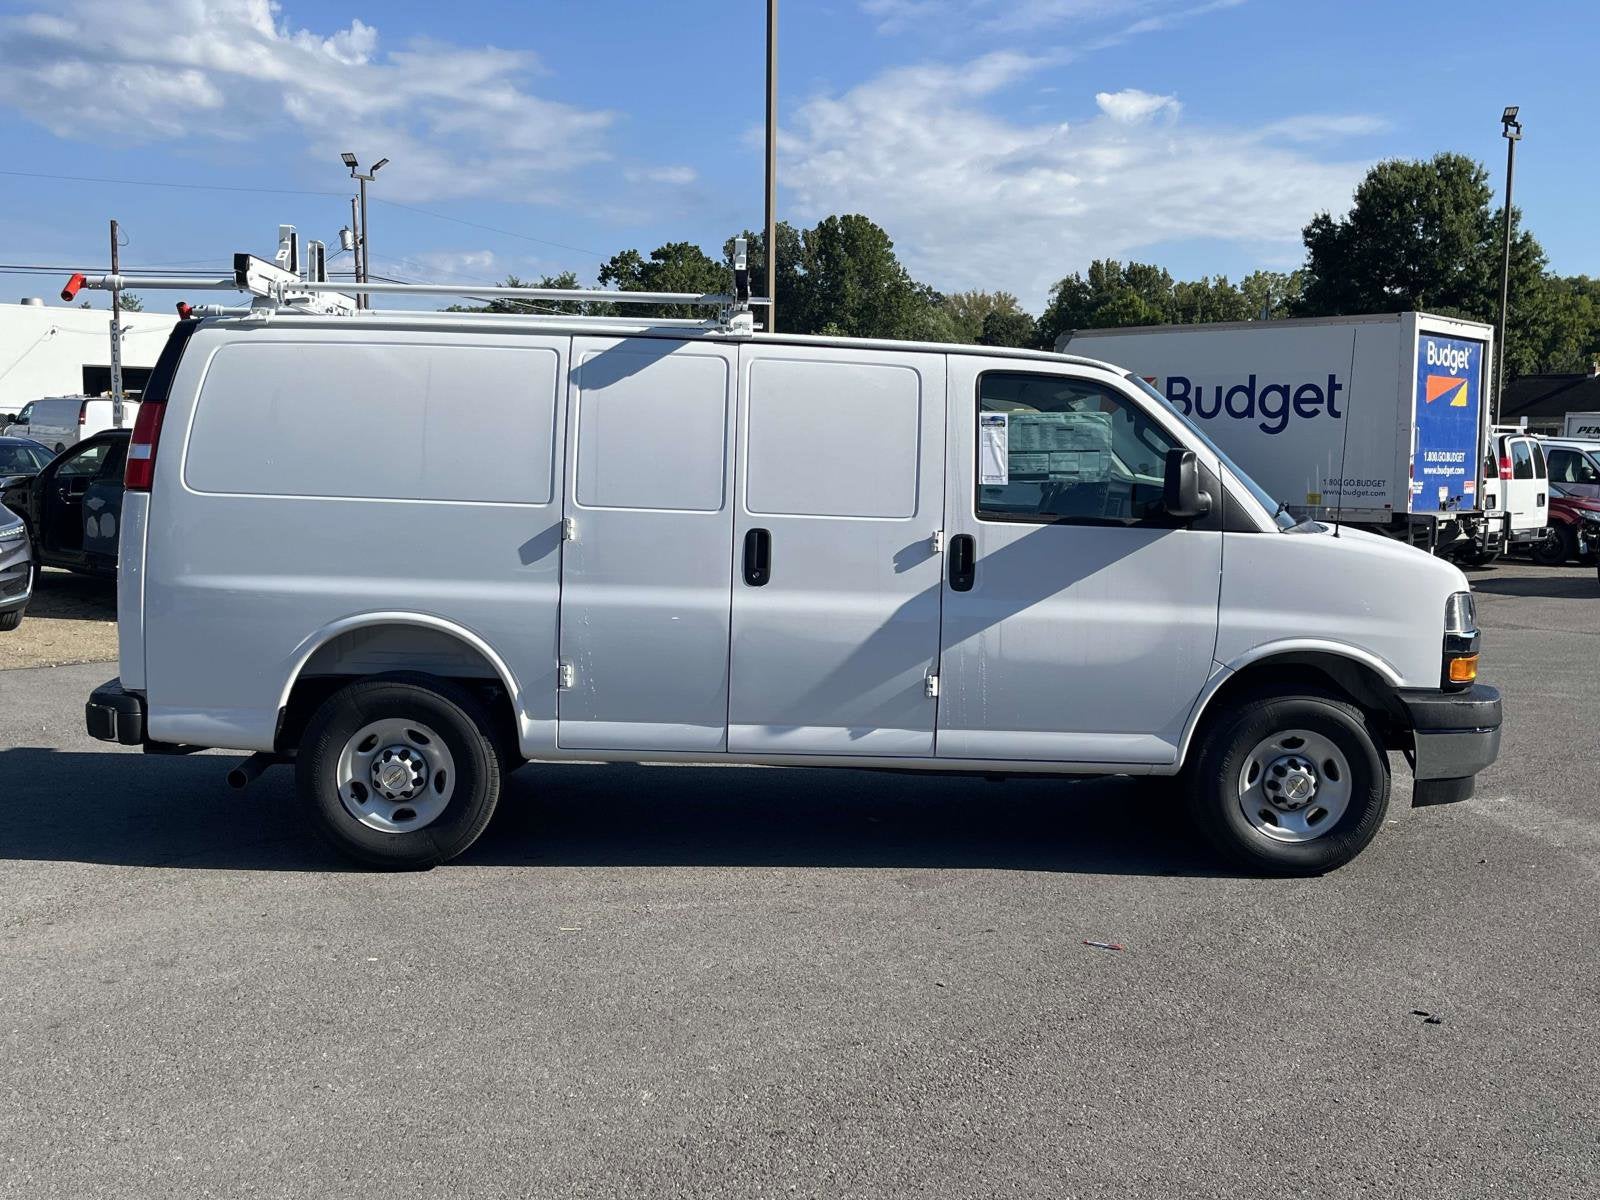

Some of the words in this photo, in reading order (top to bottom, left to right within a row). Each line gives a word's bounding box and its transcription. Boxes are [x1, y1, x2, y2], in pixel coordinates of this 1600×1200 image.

[111, 322, 120, 414] COLLISION
[1427, 340, 1470, 376] Budget
[1166, 374, 1343, 435] Budget
[1423, 465, 1465, 477] www.budget.com
[1322, 479, 1386, 488] 1.800GO.BUDGET
[1323, 489, 1386, 498] www.budget.com
